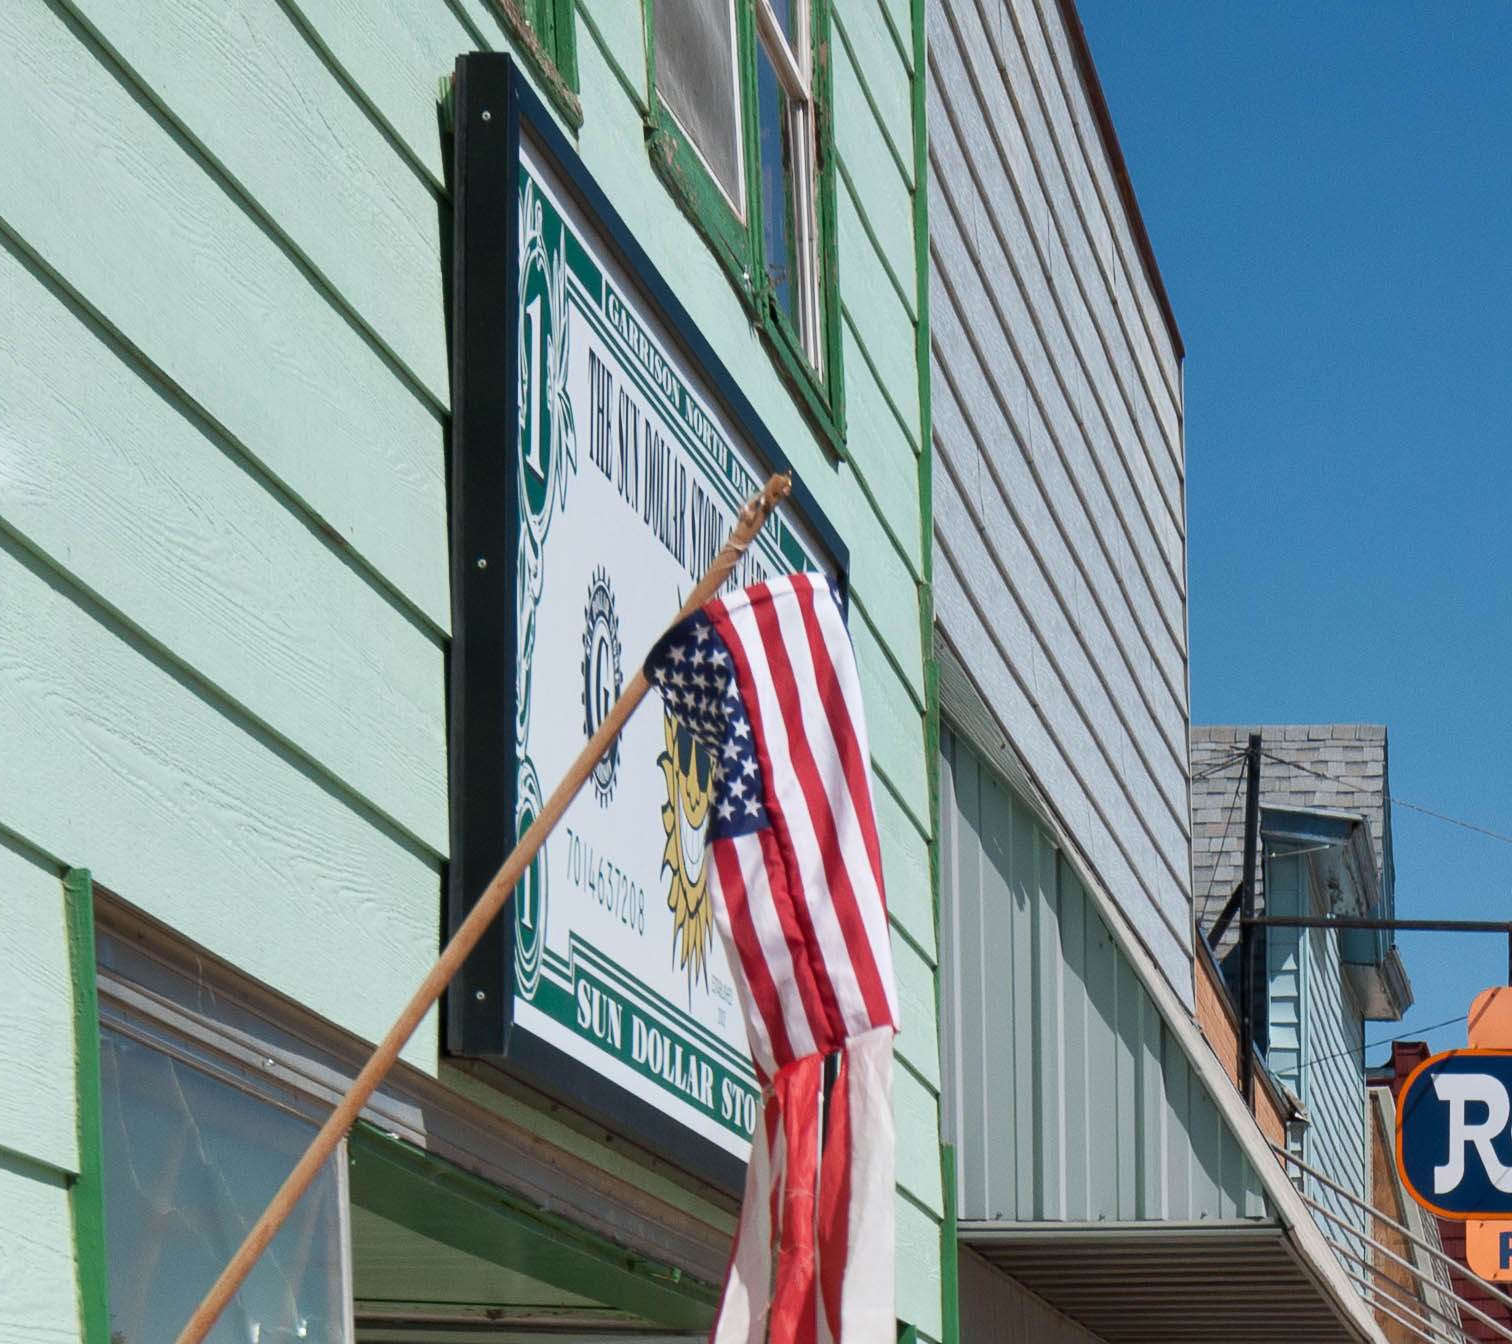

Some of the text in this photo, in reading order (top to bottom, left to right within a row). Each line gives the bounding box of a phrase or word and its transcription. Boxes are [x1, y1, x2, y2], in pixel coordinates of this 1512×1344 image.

[588, 346, 612, 482] THE
[619, 384, 640, 513] SUN
[644, 417, 686, 570] DOLLAR
[609, 294, 681, 409] GARRISON
[686, 394, 728, 475] NORTH
[566, 827, 646, 936] 7014637208
[577, 978, 756, 1136] SUN DOLLAR STO
